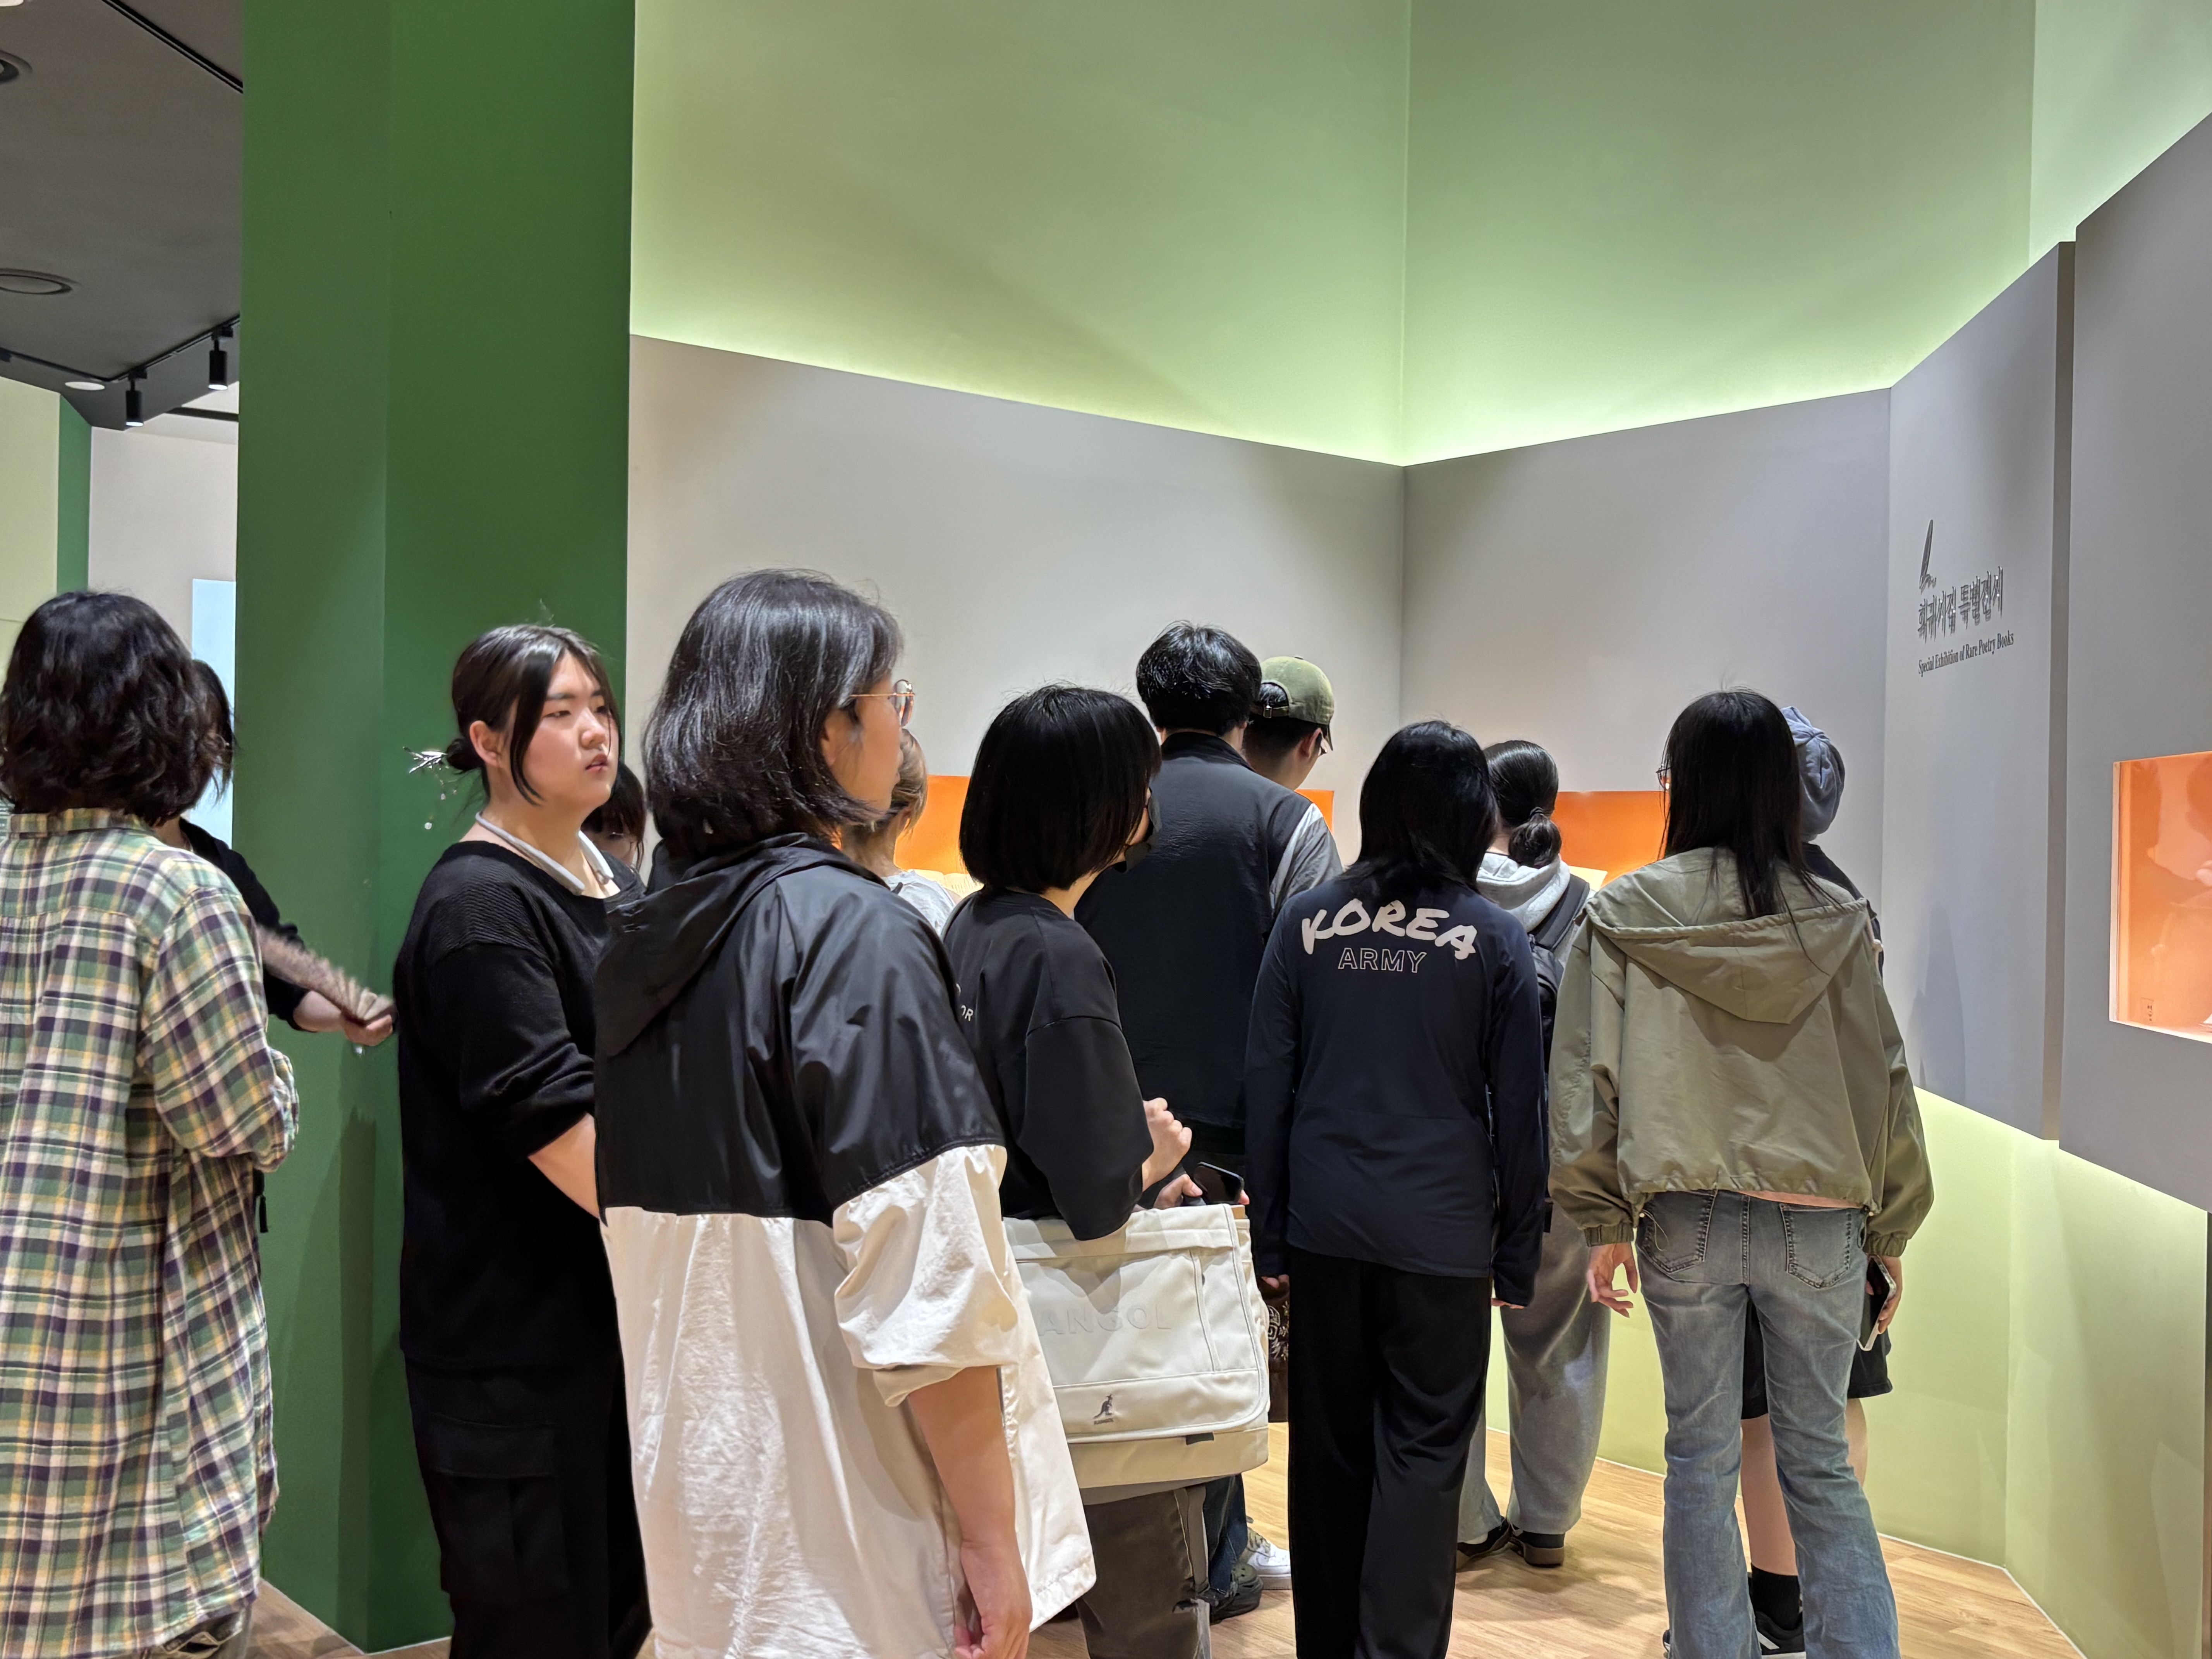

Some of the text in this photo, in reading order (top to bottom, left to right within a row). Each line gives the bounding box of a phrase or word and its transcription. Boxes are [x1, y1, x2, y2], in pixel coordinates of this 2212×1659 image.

[1958, 565, 2003, 630] 특별전시
[1918, 630, 2014, 678] Special Exhibition of Rare Poetry Books
[1302, 898, 1478, 960] KOREA
[1338, 947, 1427, 973] ARMY
[1038, 1303, 1173, 1336] ANGOL
